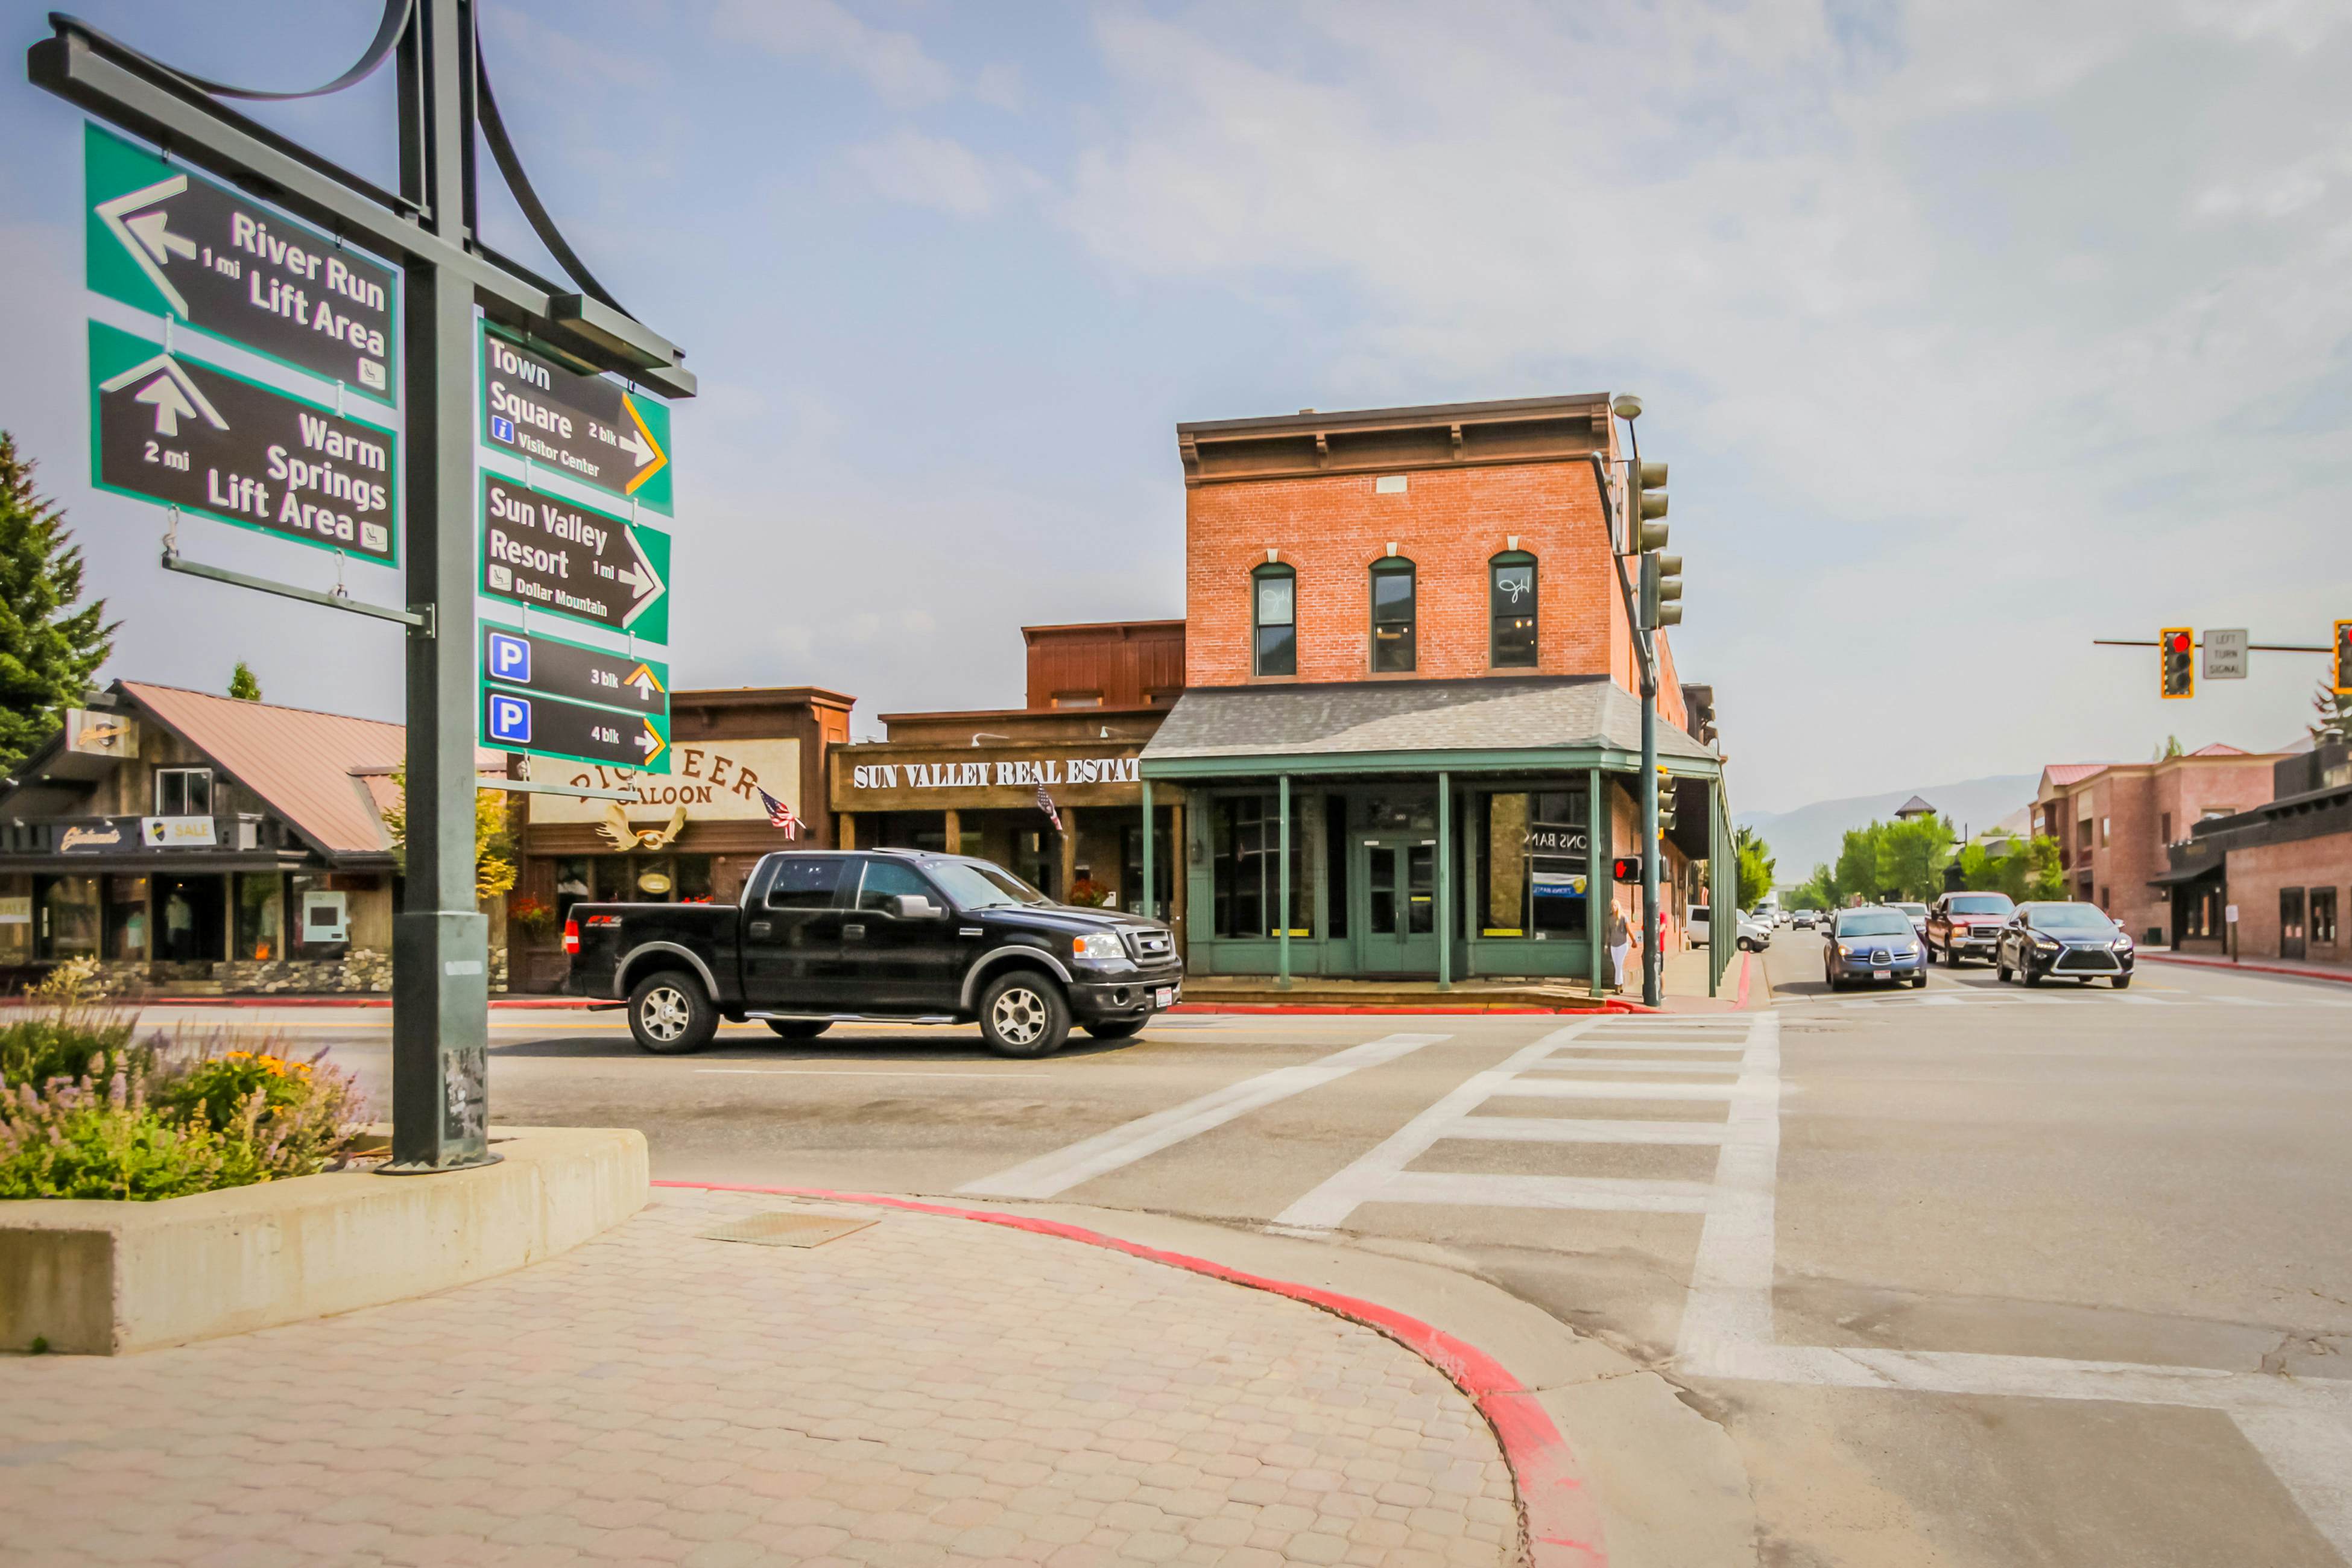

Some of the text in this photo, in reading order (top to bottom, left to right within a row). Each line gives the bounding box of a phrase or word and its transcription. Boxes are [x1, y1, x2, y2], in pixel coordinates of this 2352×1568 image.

[202, 248, 241, 280] 1 mi
[233, 212, 384, 312] River Run
[250, 270, 385, 357] Lift Area
[490, 338, 551, 391] Town
[491, 381, 572, 438] Square
[300, 414, 386, 471] Warm
[589, 422, 617, 446] 2 blk
[145, 441, 190, 471] 2 mi
[518, 432, 600, 477] Visitor Center
[268, 446, 387, 511] Springs
[209, 469, 354, 541] Lift Area
[490, 487, 608, 556] Sun Valley
[490, 529, 569, 579] Resort
[593, 561, 615, 580] 1 mi
[516, 578, 608, 617] Dollar Mountain
[2214, 650, 2238, 659] TURN
[2216, 634, 2236, 645] LEFT
[500, 641, 523, 672] P
[2209, 665, 2241, 674] SIGNAL
[591, 669, 619, 689] 3 blk
[500, 702, 523, 733] P
[591, 726, 620, 745] 4 blk
[570, 748, 758, 803] PIEER
[853, 764, 899, 789] SUN
[903, 763, 991, 788] VALLEY
[995, 760, 1061, 786] REAL
[175, 824, 209, 836] SALE
